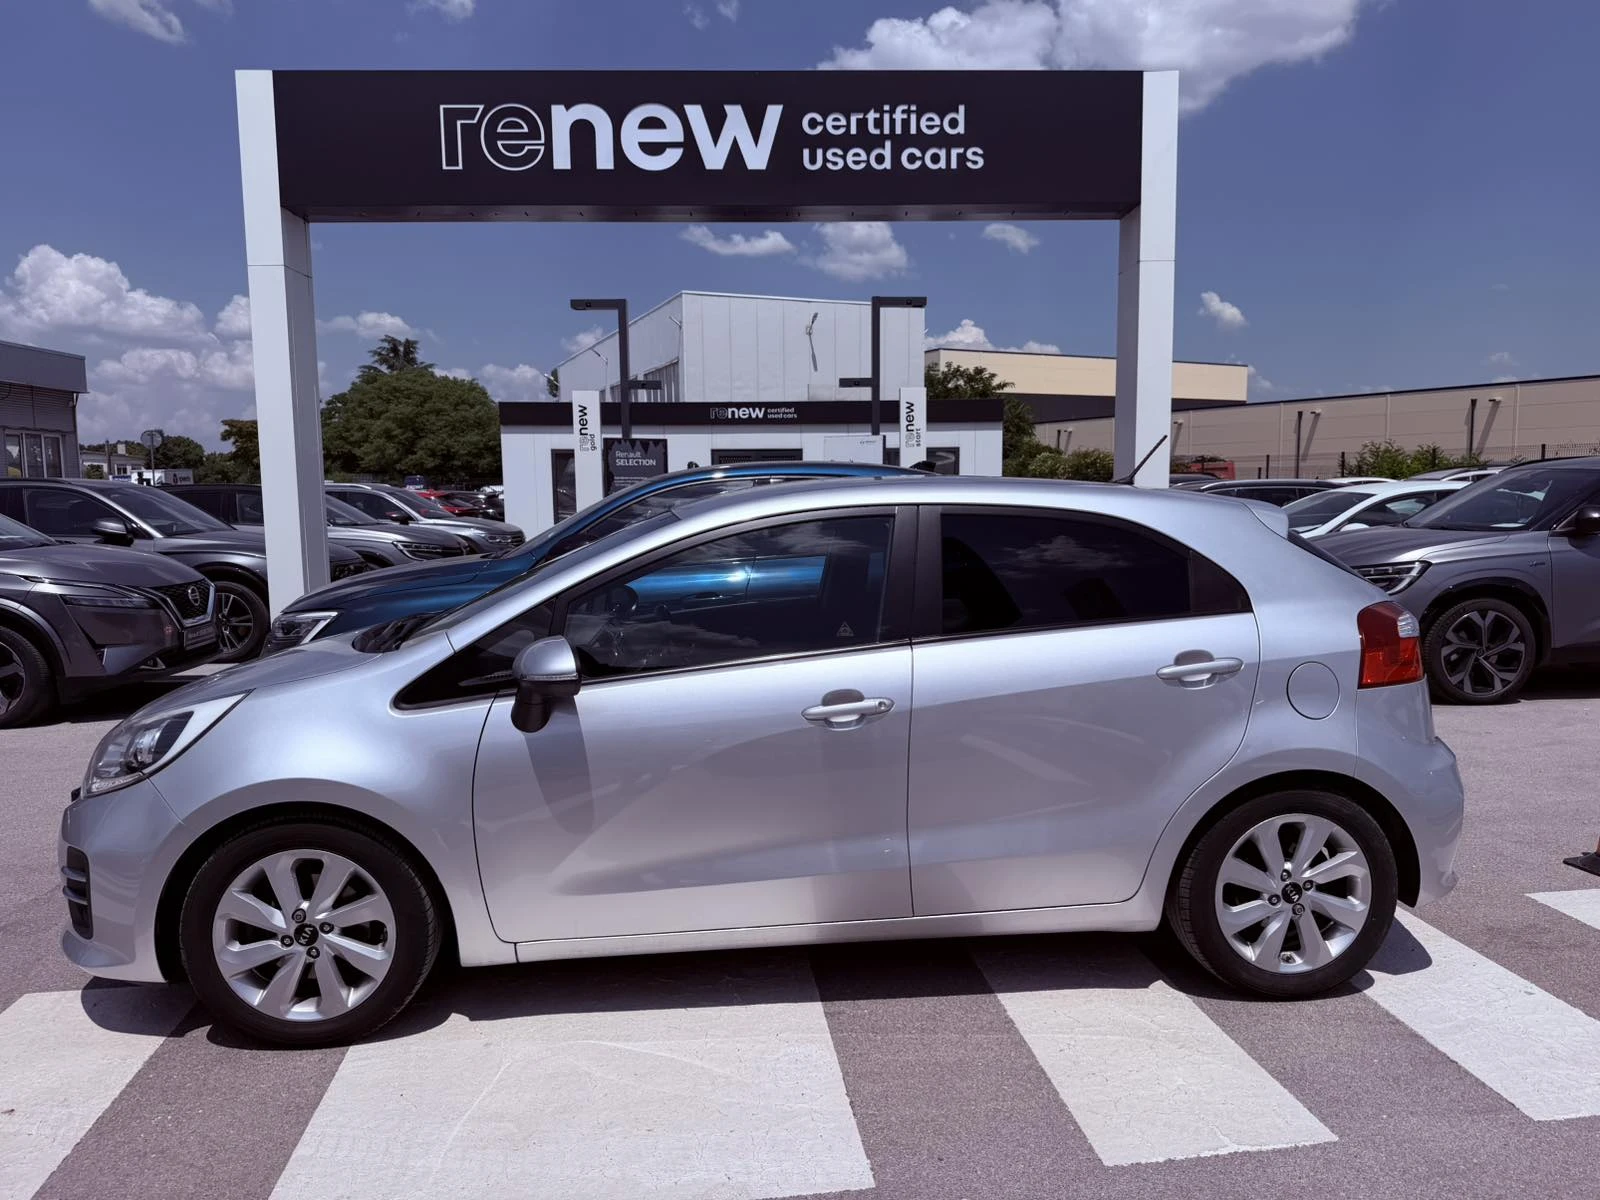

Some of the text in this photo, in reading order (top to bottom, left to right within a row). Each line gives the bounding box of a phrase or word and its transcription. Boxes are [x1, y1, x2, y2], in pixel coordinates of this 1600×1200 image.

[802, 104, 965, 136] certified
[440, 103, 784, 171] renew
[803, 140, 985, 171] used cars
[710, 407, 765, 419] renew
[905, 401, 915, 448] renew
[578, 405, 589, 452] renew
[589, 434, 597, 451] gold
[615, 450, 641, 458] Renault
[1285, 885, 1299, 902] KIA
[298, 927, 314, 944] KIA
